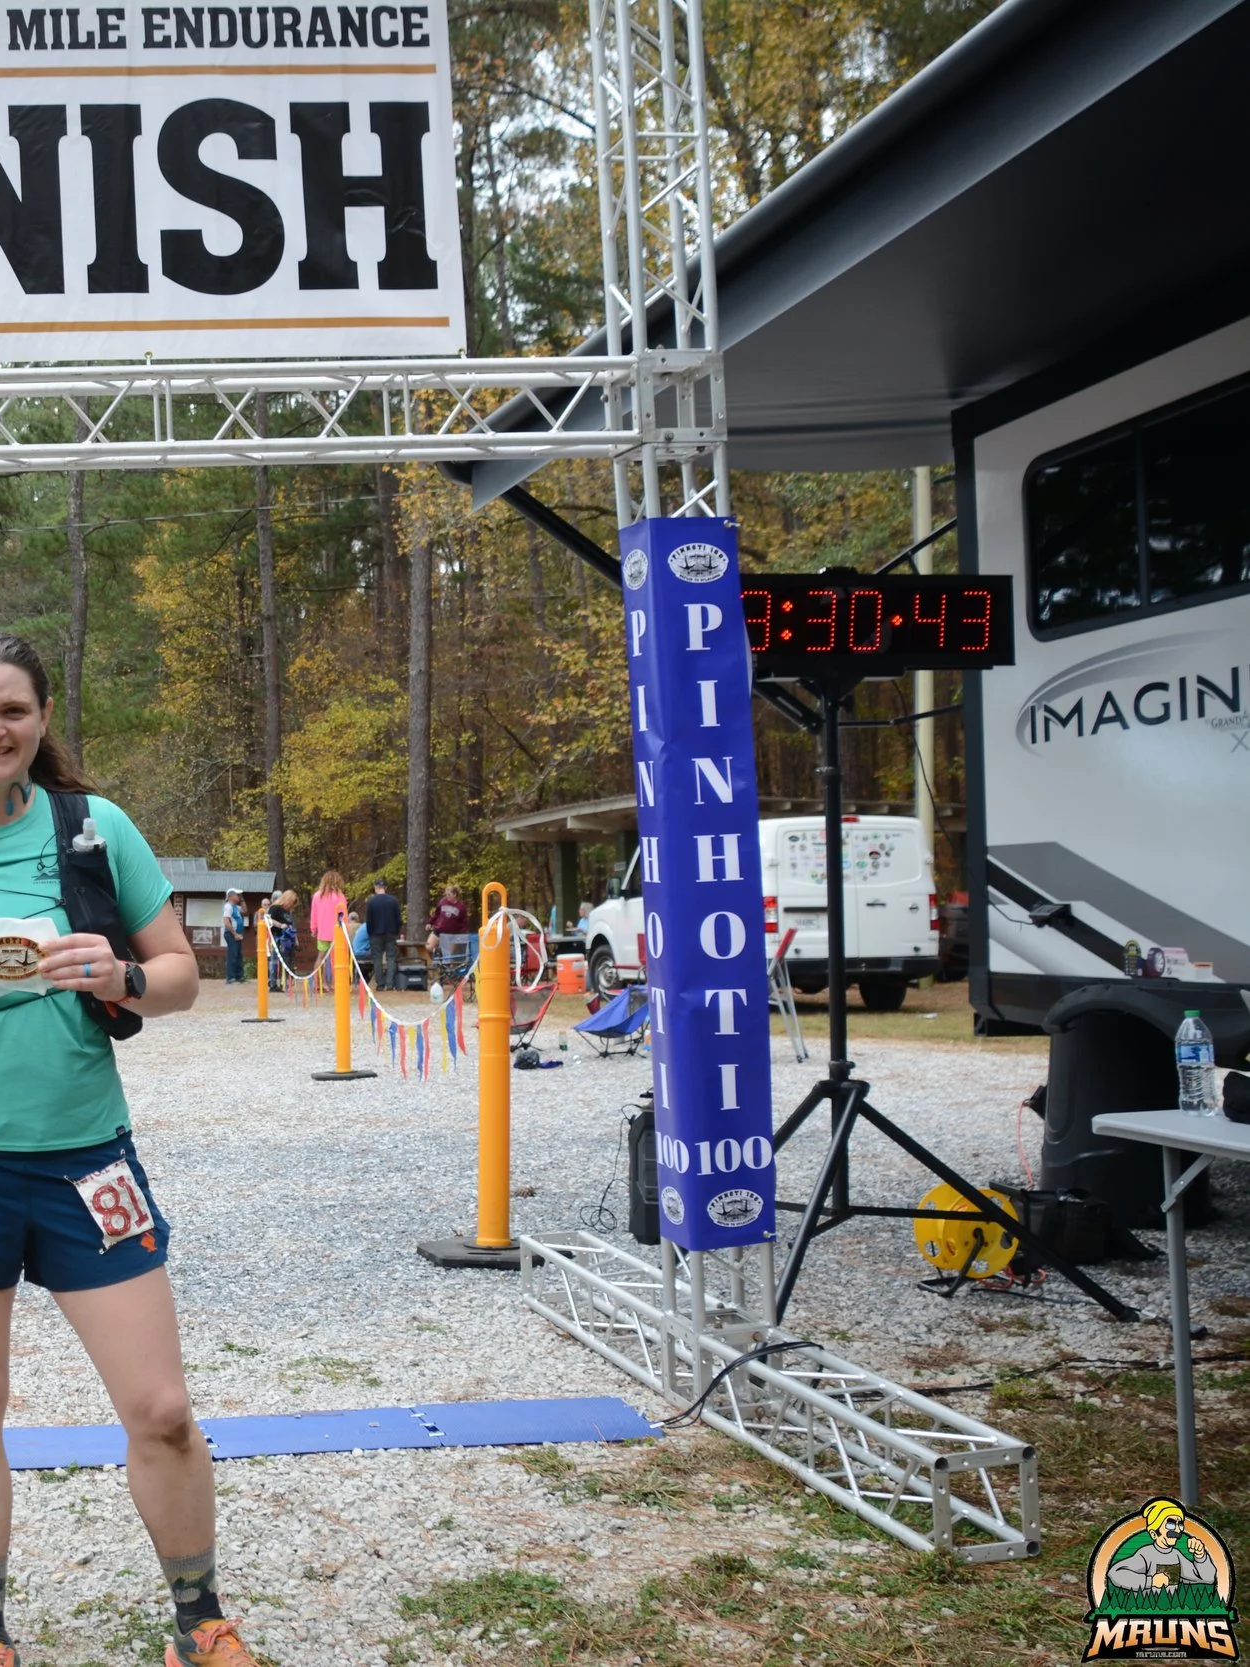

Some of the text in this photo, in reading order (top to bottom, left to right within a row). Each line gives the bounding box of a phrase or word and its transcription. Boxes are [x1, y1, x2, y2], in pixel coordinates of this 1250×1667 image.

[7, 8, 127, 51] MILE
[143, 5, 431, 50] ENDURANCE
[1030, 666, 1250, 745] IMAGIN
[630, 609, 671, 1111] PINHOTI
[683, 603, 748, 1112] PINHOTI
[655, 1131, 690, 1174] 100
[694, 1135, 773, 1176] 100
[92, 1175, 149, 1237] 81
